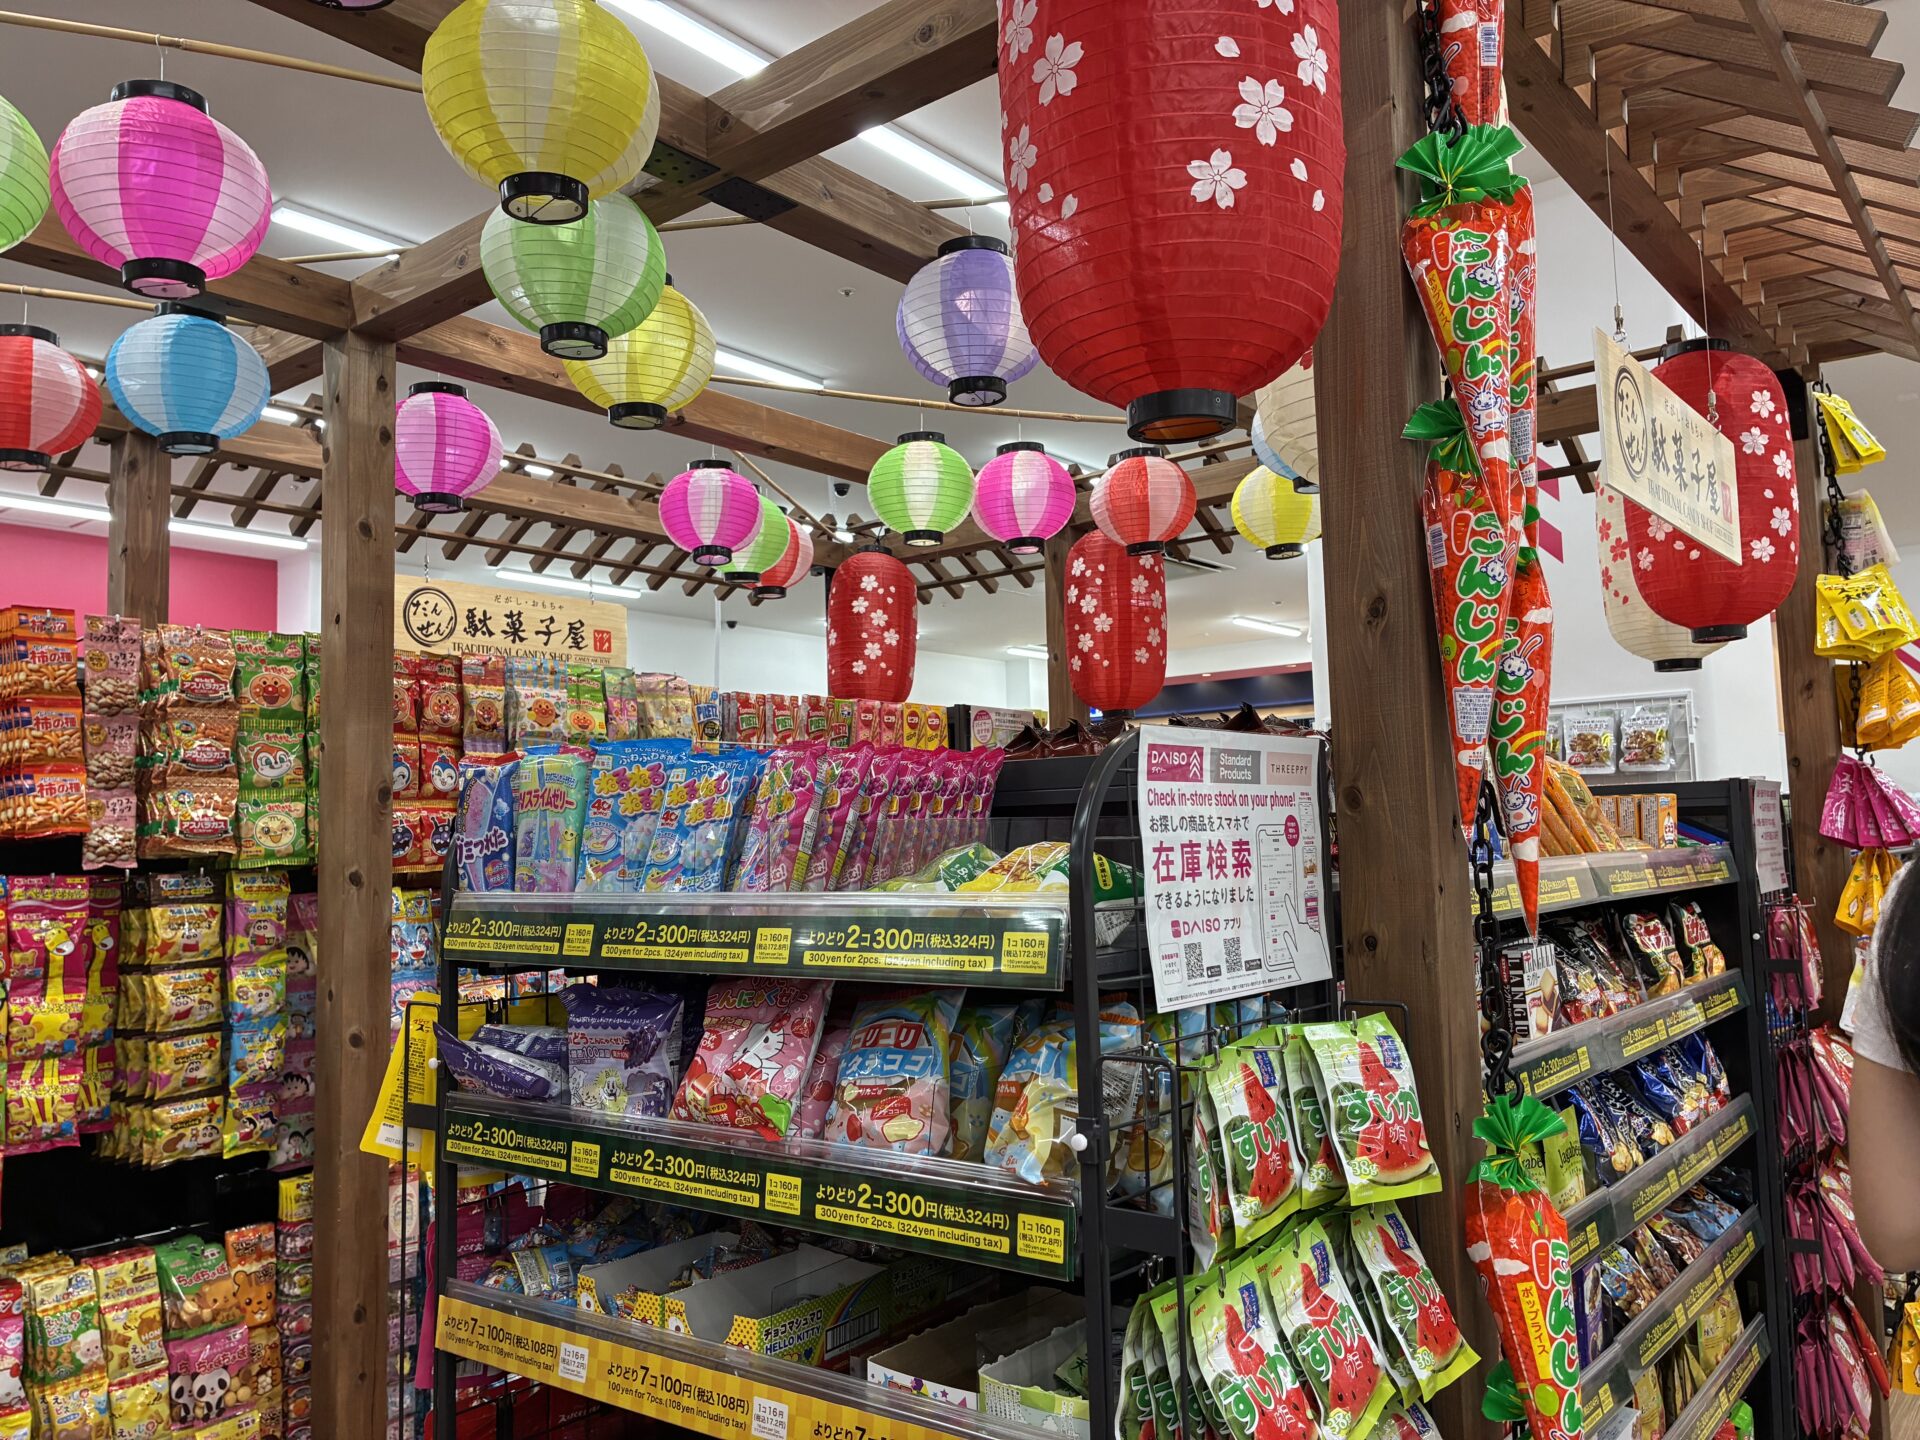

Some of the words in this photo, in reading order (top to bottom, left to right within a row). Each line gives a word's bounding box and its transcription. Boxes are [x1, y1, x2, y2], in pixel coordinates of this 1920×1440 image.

[1651, 416, 1721, 516] 駄菓子屋
[411, 599, 443, 616] だん
[494, 594, 565, 611] だがし・おもちゃ
[1451, 511, 1506, 685] にんじん
[463, 607, 589, 650] 駄菓子屋
[30, 651, 73, 665] 柿の種
[452, 641, 512, 659] TRADITIONAL
[515, 648, 548, 660] CANDY
[548, 652, 573, 663] SHOP
[33, 716, 77, 731] 柿の種
[740, 715, 759, 729] PRETZ
[775, 716, 793, 730] PRETZ
[809, 718, 827, 731] PRETZ
[1151, 750, 1187, 765] DAISO
[1219, 753, 1252, 767] Standard
[594, 762, 667, 797] ねるねる
[1219, 768, 1252, 780] Products
[1271, 763, 1308, 775] THREEPPY
[37, 781, 81, 797] 柿の種
[666, 772, 729, 808] ねるねる
[1147, 788, 1176, 806] Check
[1178, 789, 1213, 807] in-store
[1214, 790, 1237, 807] stock
[1239, 793, 1249, 807] on
[1250, 793, 1268, 811] your
[1270, 792, 1296, 811] phone!
[1150, 814, 1250, 833] お探しの商品をスマホで
[1152, 837, 1254, 884] 在庫検索
[1154, 885, 1255, 911] できるようになりました
[446, 917, 562, 938] よりどり2コ300円(税込324円)
[604, 921, 751, 945] よりどり2コ300円(税込324円)
[1182, 918, 1221, 935] DAISO
[1223, 916, 1242, 931] アプリ
[447, 939, 468, 949] 300yen
[468, 941, 477, 949] for
[476, 942, 492, 951] 2pcs.
[492, 942, 515, 952] (324yen
[514, 943, 542, 952] including
[542, 944, 556, 953] tax)
[759, 934, 789, 943] 1コ160円
[808, 924, 996, 951] よりどり2コ300円(税込324円)
[1006, 938, 1046, 949] 1コ160円
[606, 947, 631, 956] 300yen
[631, 947, 643, 956] for
[643, 948, 663, 958] 2pcs.
[664, 949, 693, 959] (324yen
[693, 950, 727, 961] including
[728, 951, 744, 961] tax)
[808, 954, 843, 965] 300yen
[843, 954, 857, 964] for
[857, 955, 882, 967] 2pcs.
[923, 956, 965, 968] including
[965, 958, 988, 969] tax)
[1004, 949, 1047, 959] (税込172.8円)
[852, 1028, 916, 1050] コリコリ
[1337, 1086, 1421, 1132] すいか
[448, 1121, 567, 1155] よりどり2コ300円(税込324円)
[1231, 1103, 1288, 1172] すいか
[1389, 1125, 1408, 1143] グミ
[450, 1142, 472, 1154] 300yen
[472, 1145, 481, 1154] for
[480, 1147, 496, 1158] 2pcs.
[497, 1149, 521, 1162] (324yen
[521, 1153, 550, 1167] including
[550, 1158, 563, 1170] tax)
[611, 1149, 760, 1187] よりどり2コ300円(税込324円)
[1350, 1160, 1379, 1177] 38g
[614, 1171, 639, 1183] 300yen
[639, 1175, 652, 1185] for
[652, 1176, 672, 1189] 2pcs.
[673, 1179, 703, 1194] (324yen
[704, 1184, 738, 1200] including
[739, 1191, 755, 1204] tax)
[769, 1178, 799, 1191] 1コ160円
[815, 1183, 1010, 1231] よりどり2コ300円(税込324円)
[820, 1207, 855, 1221] 300yen
[855, 1212, 869, 1224] for
[870, 1214, 895, 1231] 2pcs.
[897, 1220, 936, 1237] (324yen
[937, 1227, 981, 1246] including
[982, 1236, 1004, 1250] tax)
[1021, 1219, 1061, 1236] 1コ160円
[1018, 1232, 1063, 1248] (税込172.8円)
[1387, 1265, 1444, 1319] すいか
[763, 1308, 824, 1341] チョコマシュマロ
[1520, 1285, 1551, 1356] ポップライス
[444, 1315, 559, 1360] よりどり7コ100円(税込108円)
[764, 1335, 794, 1356] HELLO
[795, 1324, 822, 1347] KITTY
[1297, 1303, 1365, 1383] すいか
[563, 1348, 585, 1362] 1コ16円
[1344, 1351, 1365, 1379] グミ
[1414, 1349, 1436, 1370] 38g
[607, 1361, 750, 1415] よりどり7コ100円(税込108円)
[1218, 1343, 1300, 1436] すいか
[608, 1381, 634, 1397] 100yen
[634, 1387, 646, 1399] for
[646, 1390, 666, 1407] 7pcs.
[665, 1395, 693, 1414] (108yen
[695, 1405, 731, 1425] including
[731, 1416, 747, 1432] tax)
[758, 1403, 784, 1418] 1コ16円
[753, 1413, 787, 1430] (税込17.2円)
